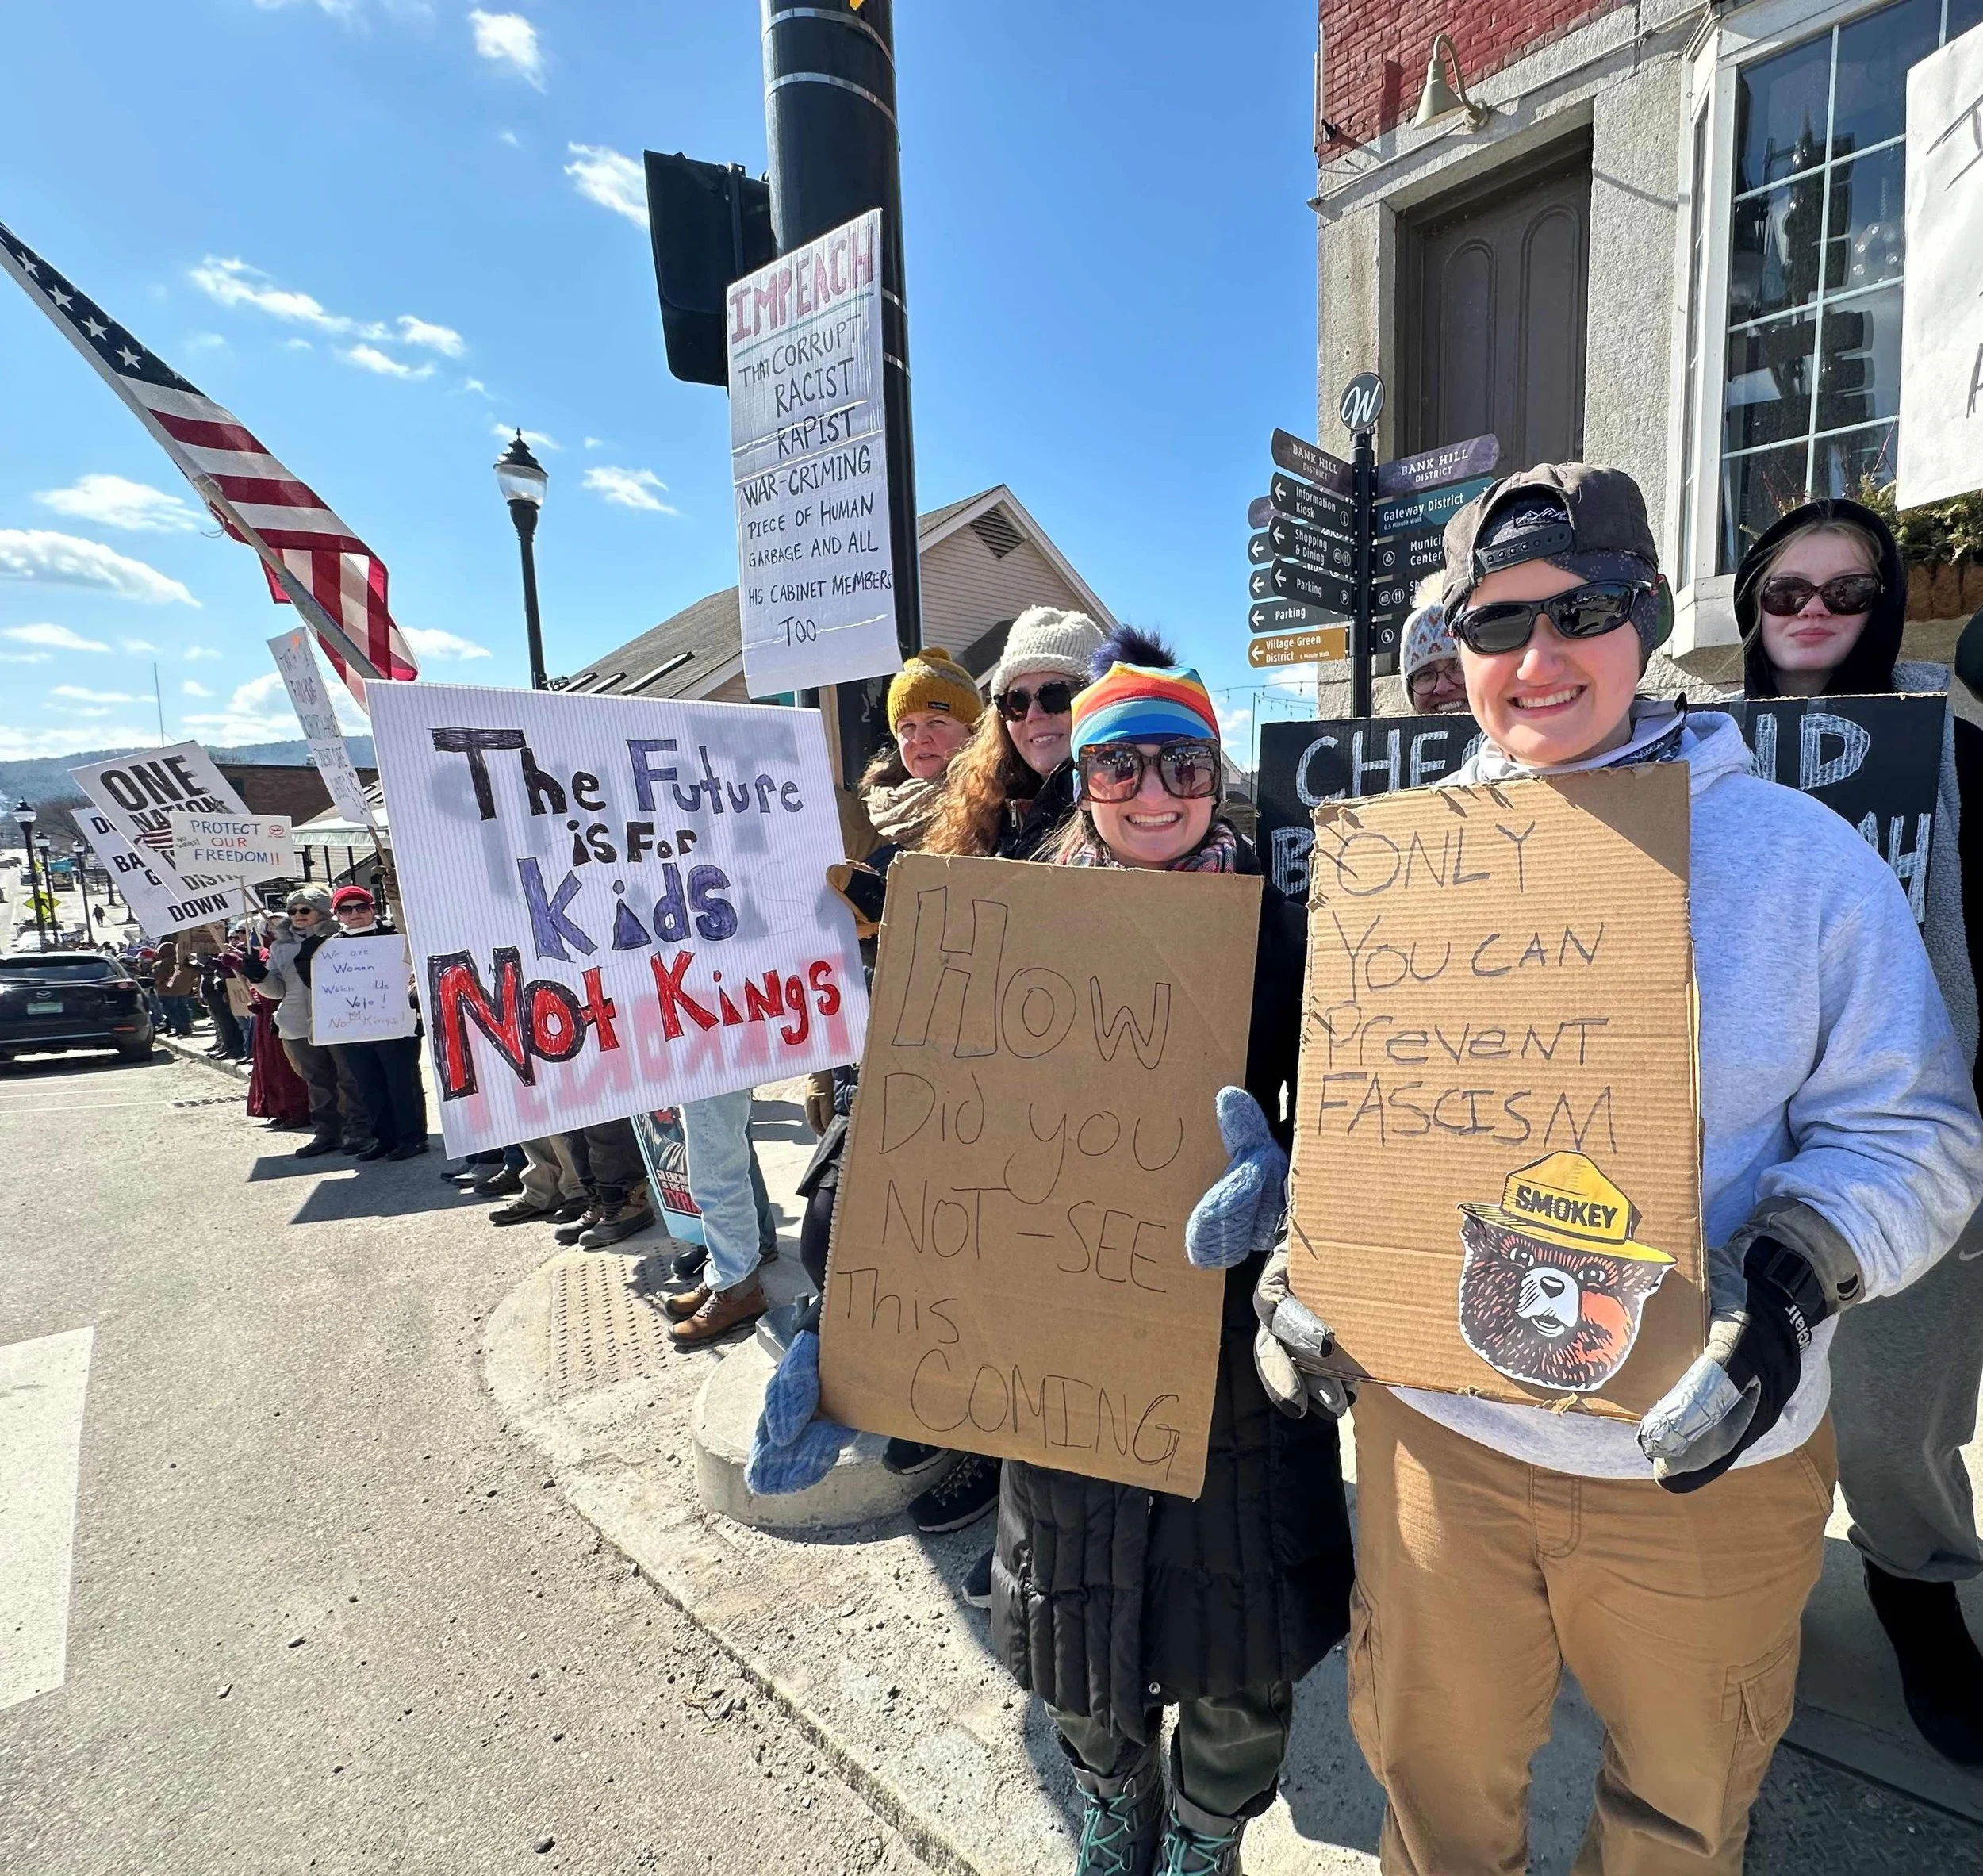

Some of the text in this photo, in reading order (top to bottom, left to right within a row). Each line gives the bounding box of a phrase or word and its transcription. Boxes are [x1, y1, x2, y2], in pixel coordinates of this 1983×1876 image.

[729, 223, 874, 344] IMPEACH
[738, 314, 861, 387] THAT CORRUPT
[774, 357, 854, 417] RACIST
[777, 407, 856, 459] RAPIST
[1292, 443, 1338, 474] BANK HILL
[1302, 462, 1329, 480] DISTRICT
[1401, 449, 1468, 476] BANK HILL
[742, 444, 871, 508] WAR-CRIMING
[1415, 466, 1452, 483] DISTRICT
[1296, 485, 1336, 512] Information
[1296, 501, 1315, 519] Kiosk
[1383, 493, 1463, 522] Gateway District
[747, 514, 785, 539] PIECE
[795, 506, 812, 527] OF
[1392, 520, 1409, 528] Minute
[748, 530, 879, 567] GARBAGE AND ALL
[1295, 529, 1327, 552] Shopping
[1295, 544, 1325, 566] & Dining
[1410, 551, 1443, 566] Center
[748, 570, 894, 608] HIS CABINET MEMBERS
[1296, 578, 1322, 598] Parking
[1275, 607, 1306, 620] Parking
[777, 616, 817, 646] TOO
[1265, 635, 1321, 650] Village Green
[1265, 651, 1295, 663] District
[100, 754, 210, 811] ONE
[428, 727, 607, 820] The
[625, 739, 804, 814] Future
[190, 819, 261, 835] PROTECT
[211, 837, 247, 847] OUR
[1336, 820, 1536, 897] ONLY
[167, 893, 229, 923] DOWN
[517, 857, 738, 962] Kids
[321, 950, 340, 960] We
[1471, 923, 1605, 977] CAN
[333, 962, 375, 974] Women
[374, 980, 389, 990] Us
[328, 1018, 347, 1029] No
[427, 946, 620, 1102] Not
[879, 1070, 984, 1155] Did
[1318, 1072, 1617, 1155] FASCISM
[1514, 1185, 1618, 1229] SMOKEY
[836, 1268, 960, 1344] This
[910, 1348, 1180, 1482] COMING
